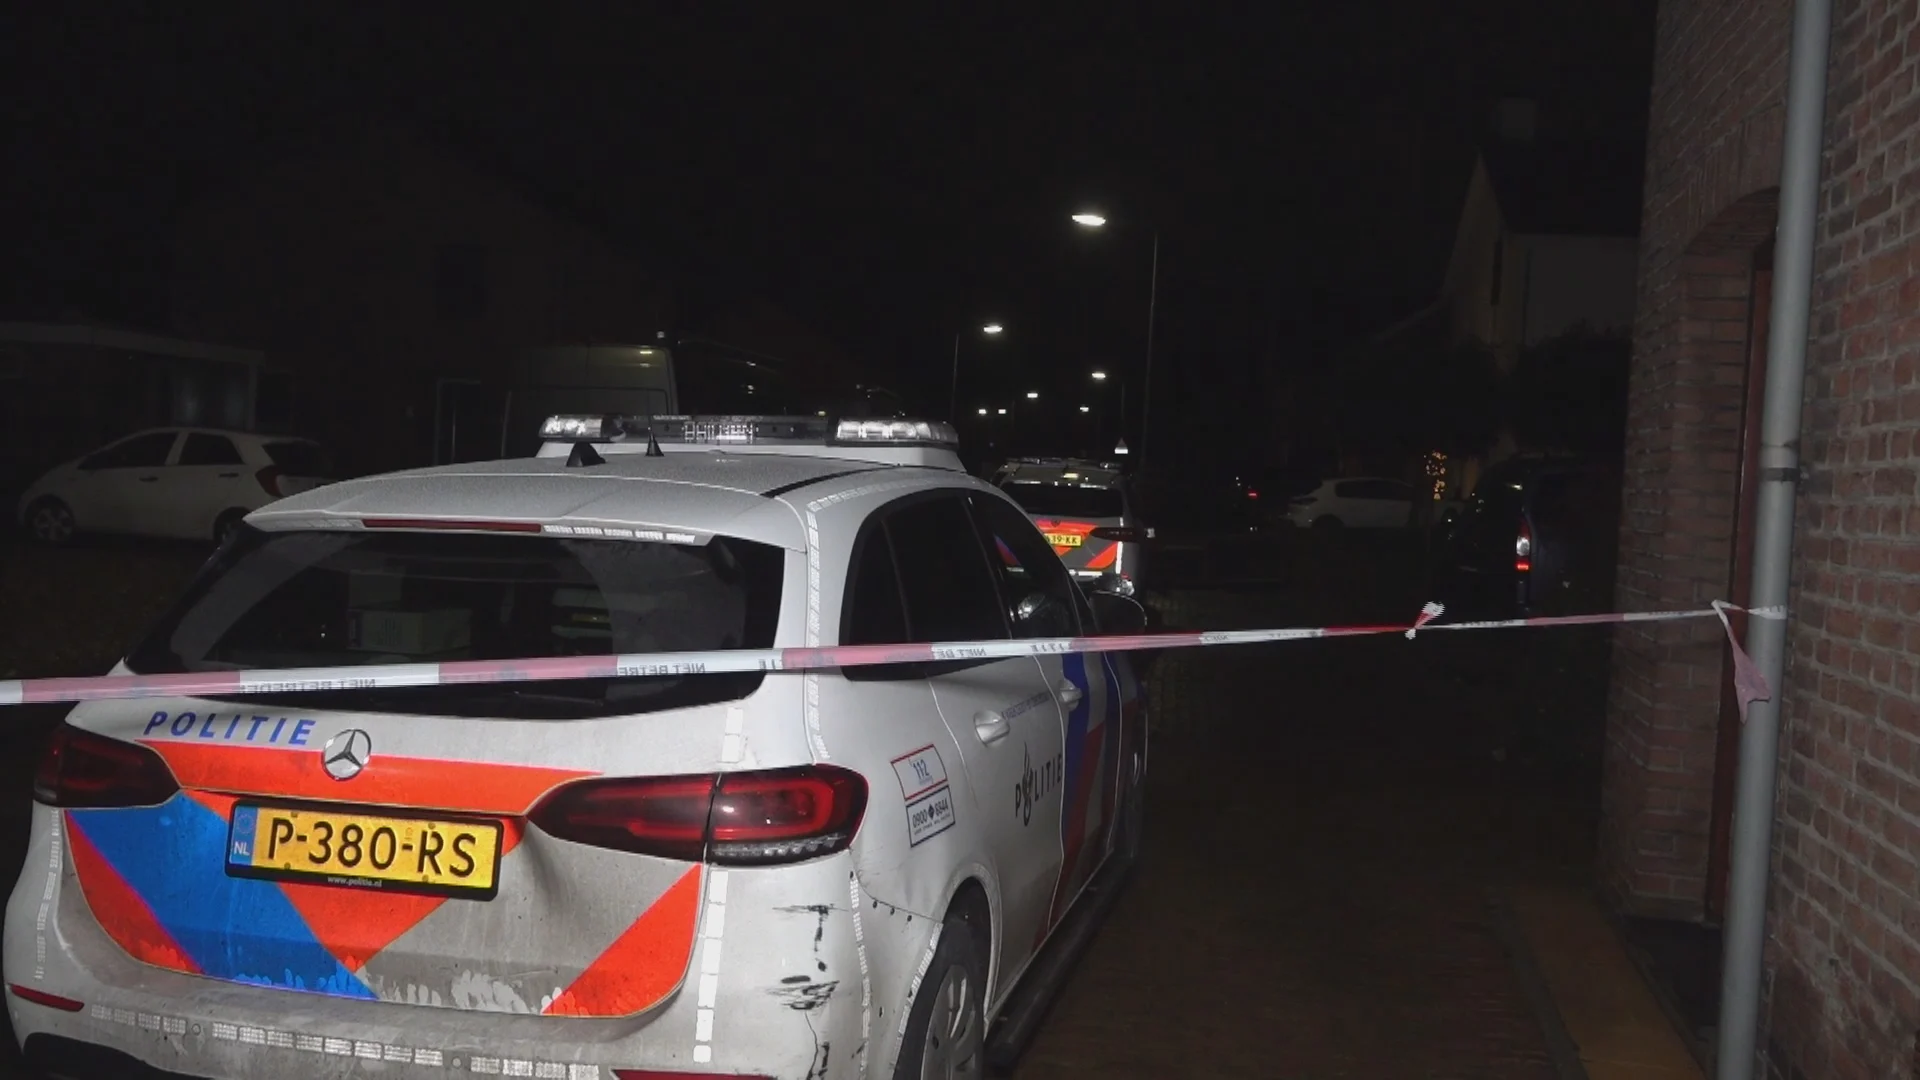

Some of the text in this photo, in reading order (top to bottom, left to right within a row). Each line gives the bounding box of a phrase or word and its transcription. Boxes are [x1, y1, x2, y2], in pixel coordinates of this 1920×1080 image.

[143, 710, 316, 745] POLITIE
[912, 759, 930, 780] 112
[912, 808, 928, 829] 0900
[233, 841, 250, 855] NL
[268, 816, 477, 878] P-380-RS
[327, 875, 383, 889] www.politie.nl
